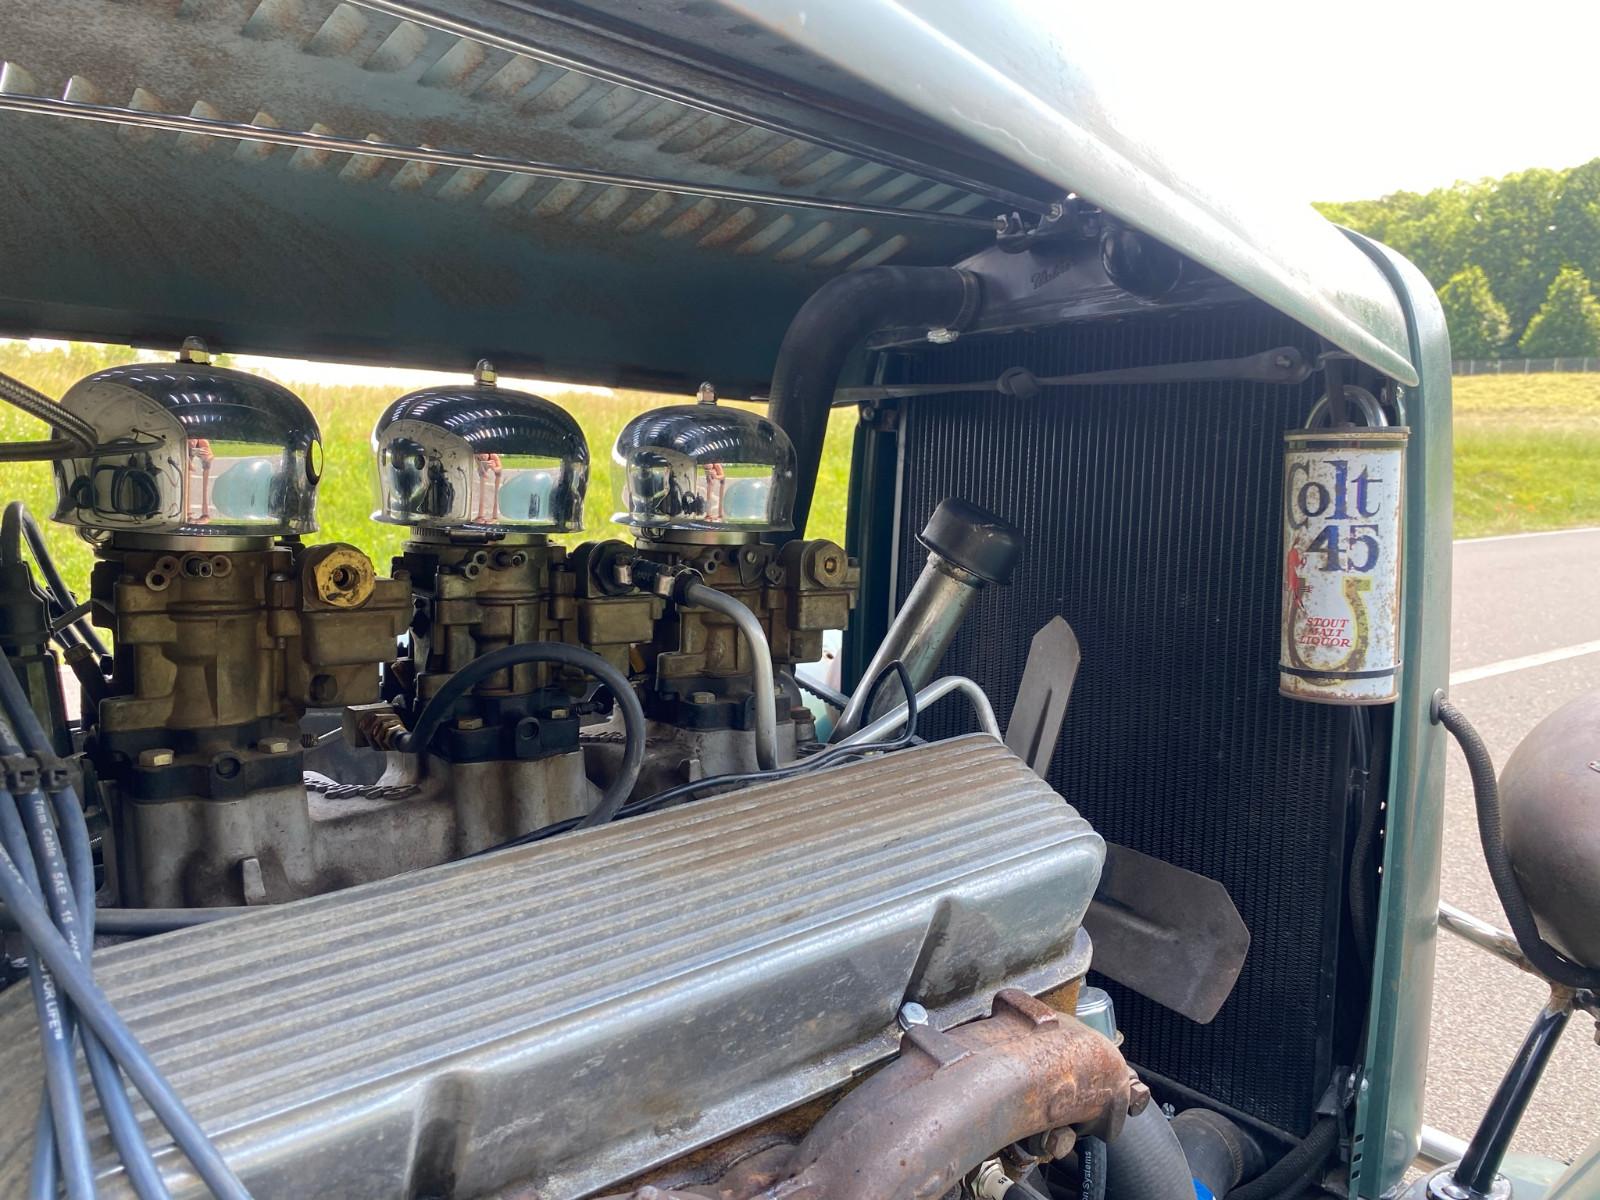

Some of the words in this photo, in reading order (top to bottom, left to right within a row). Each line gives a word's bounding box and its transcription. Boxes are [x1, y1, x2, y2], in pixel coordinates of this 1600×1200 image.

[1286, 459, 1384, 529] Colt
[1303, 524, 1380, 573] 45
[1306, 617, 1349, 628] STOUT
[1309, 627, 1344, 637] MALT
[1299, 635, 1351, 648] LIQUOR
[34, 799, 48, 824] 7mm
[42, 828, 57, 857] Cable
[52, 872, 68, 895] SAE
[41, 974, 57, 1001] FOR
[1082, 1151, 1093, 1190] Systems
